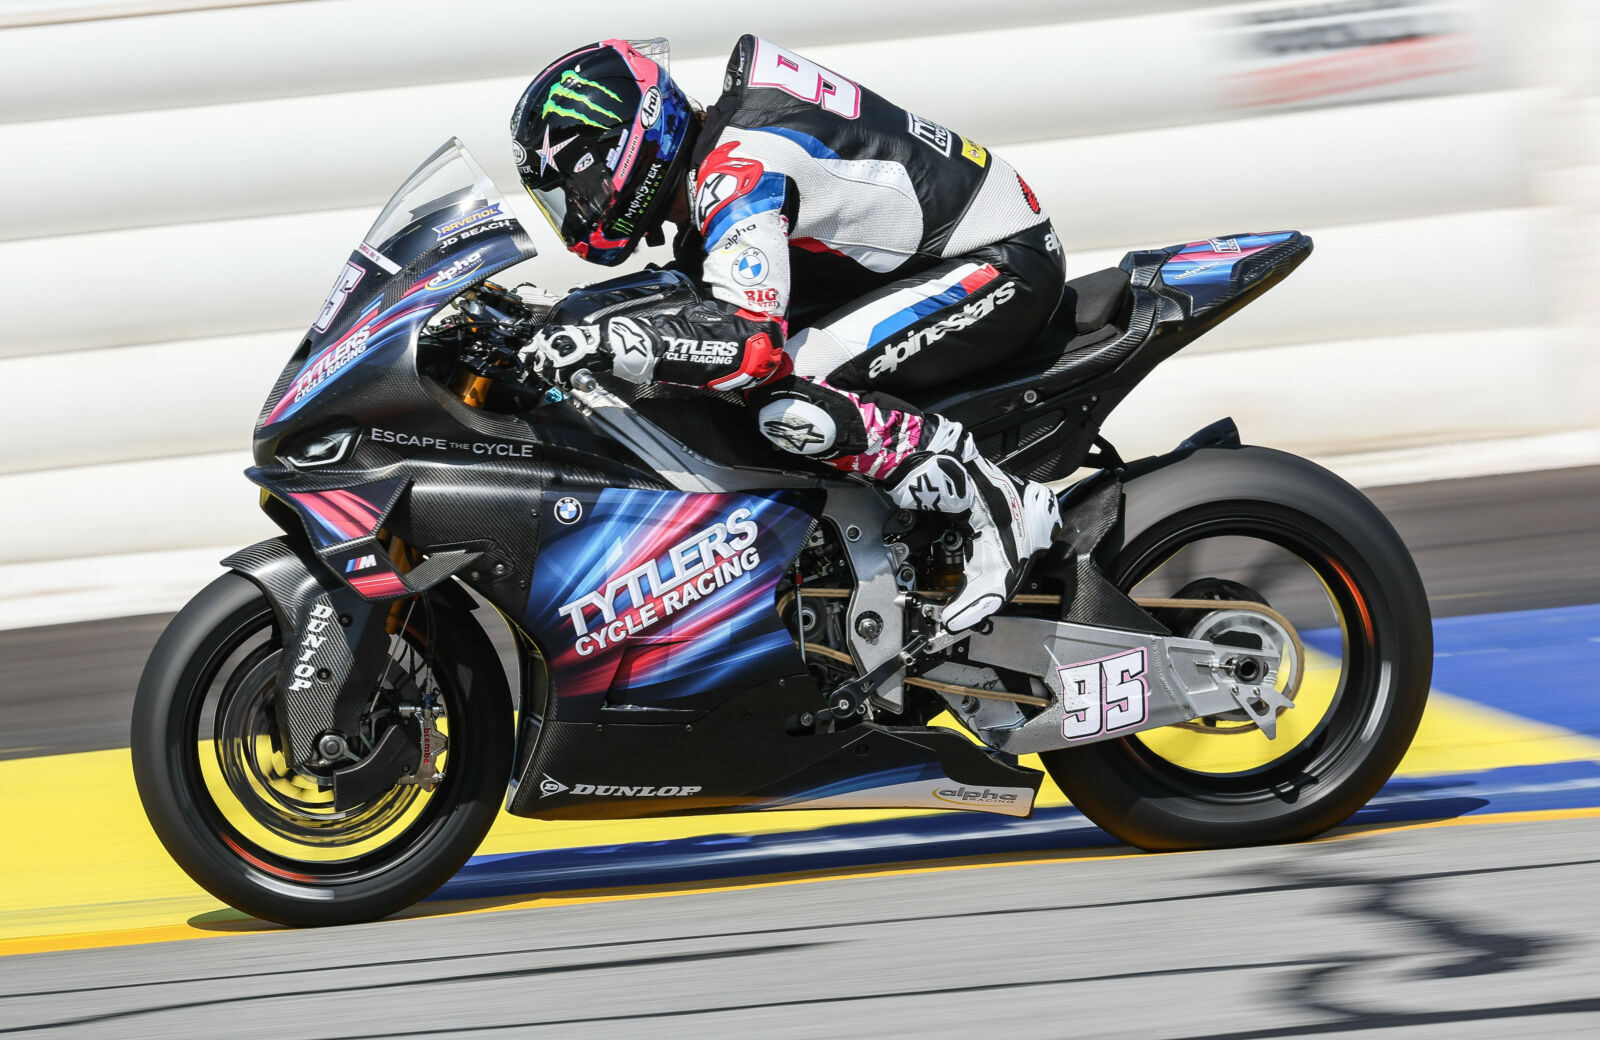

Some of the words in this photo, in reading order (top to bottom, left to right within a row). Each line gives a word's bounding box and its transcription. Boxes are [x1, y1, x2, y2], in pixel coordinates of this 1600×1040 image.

[642, 90, 659, 128] Arai
[624, 163, 662, 218] MONSTER
[440, 237, 459, 249] JD
[459, 220, 510, 240] BEACH
[441, 207, 498, 234] RAVENOL
[724, 223, 757, 250] alpha
[428, 249, 483, 287] alpha
[744, 287, 777, 302] BIG
[660, 335, 739, 356] YTLERS
[868, 281, 1016, 379] alpinestars
[294, 371, 327, 403] CYCLE
[326, 343, 367, 377] RACING
[295, 324, 371, 393] TYTLERS
[689, 354, 733, 365] RACING
[371, 428, 447, 450] ESCAPE
[448, 441, 470, 450] THE
[472, 442, 534, 458] CYCLE
[558, 507, 759, 637] TYTLERS
[575, 603, 659, 656] CYCLE
[662, 547, 761, 616] RACING
[288, 603, 333, 691] DUNLOP
[1055, 646, 1149, 742] 95
[569, 783, 702, 797] DUNLOP
[938, 786, 1018, 801] alpha
